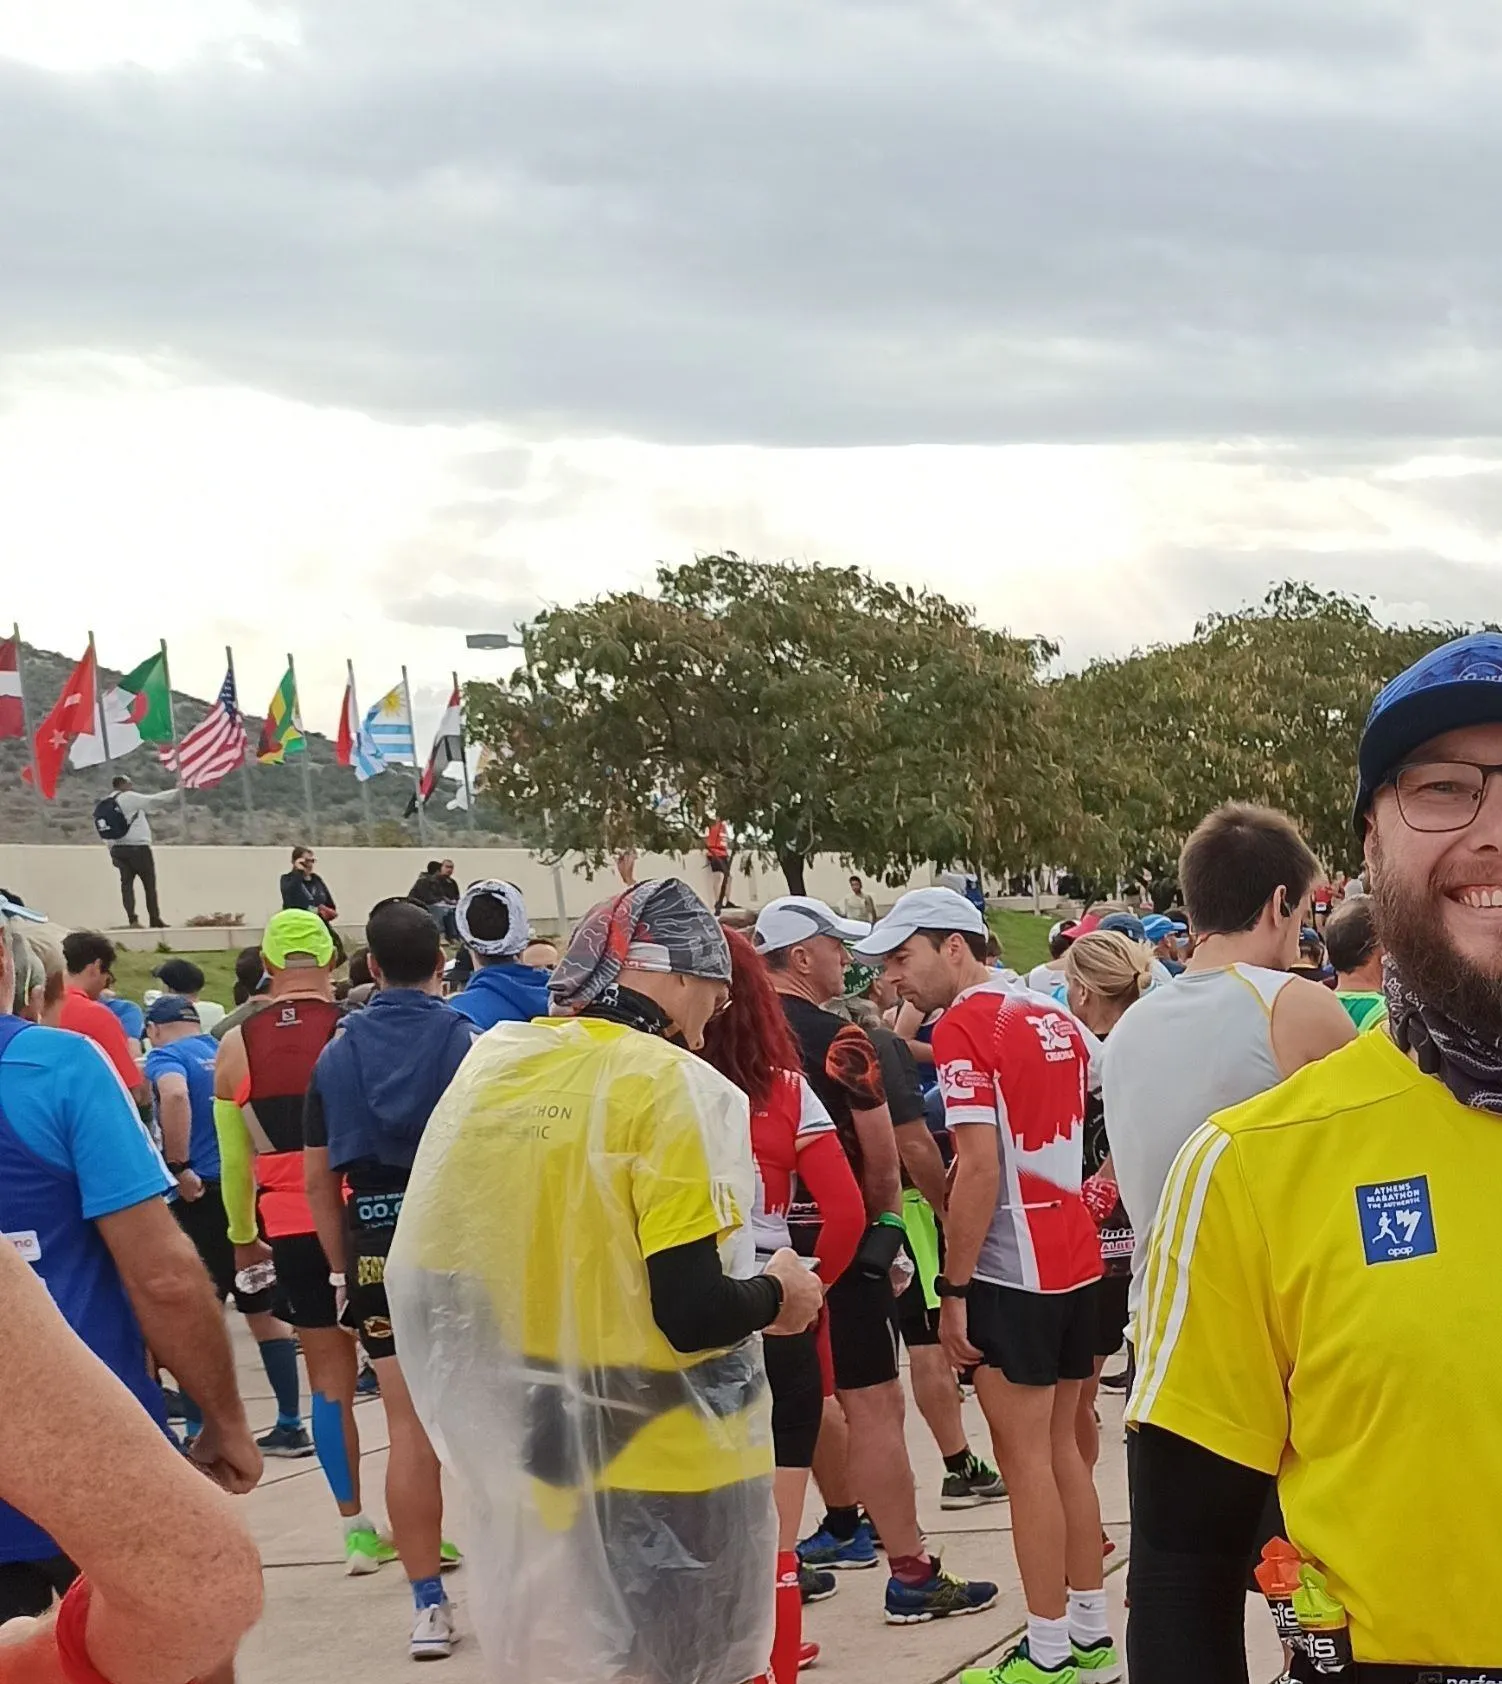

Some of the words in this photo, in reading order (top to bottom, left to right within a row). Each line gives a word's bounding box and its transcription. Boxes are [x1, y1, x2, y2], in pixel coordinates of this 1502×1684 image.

[1374, 1182, 1411, 1195] ATHENS
[1366, 1189, 1420, 1203] MARATHON
[1387, 1246, 1414, 1257] opap
